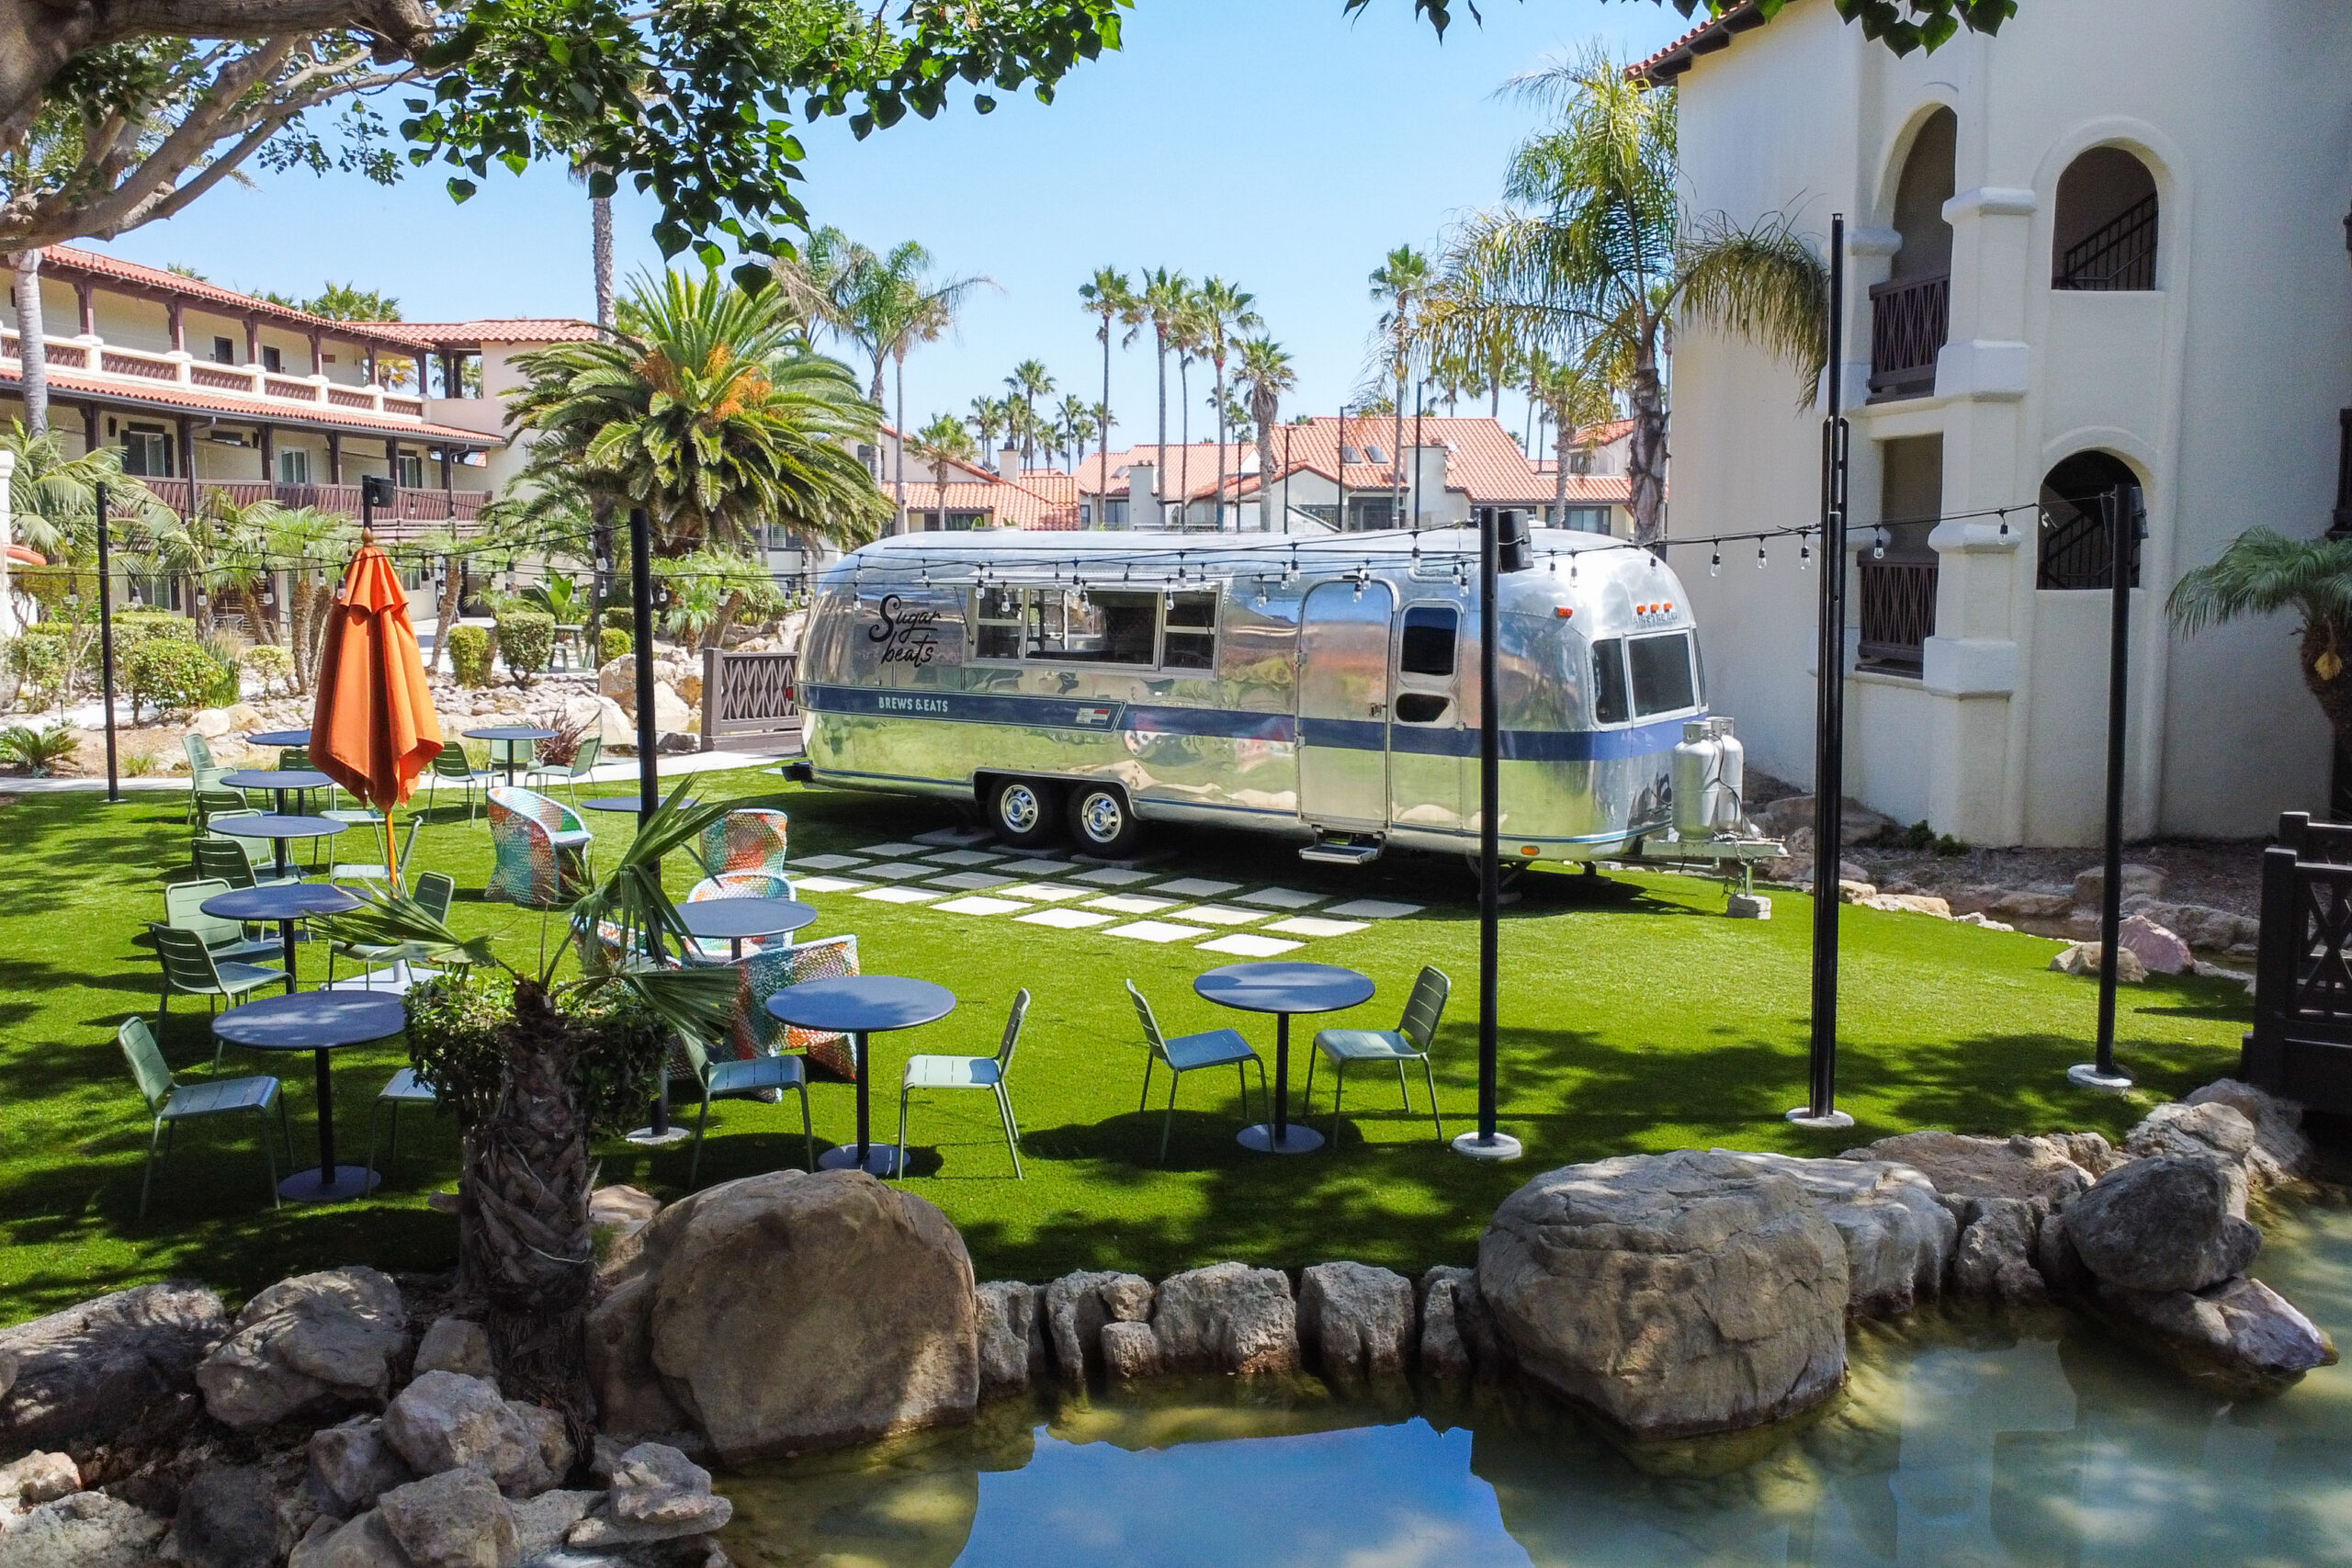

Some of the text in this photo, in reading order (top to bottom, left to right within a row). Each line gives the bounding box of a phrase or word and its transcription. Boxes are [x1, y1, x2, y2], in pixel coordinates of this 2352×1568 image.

[869, 594, 941, 643] Sugar
[881, 631, 938, 668] beats
[878, 697, 913, 710] BREWS
